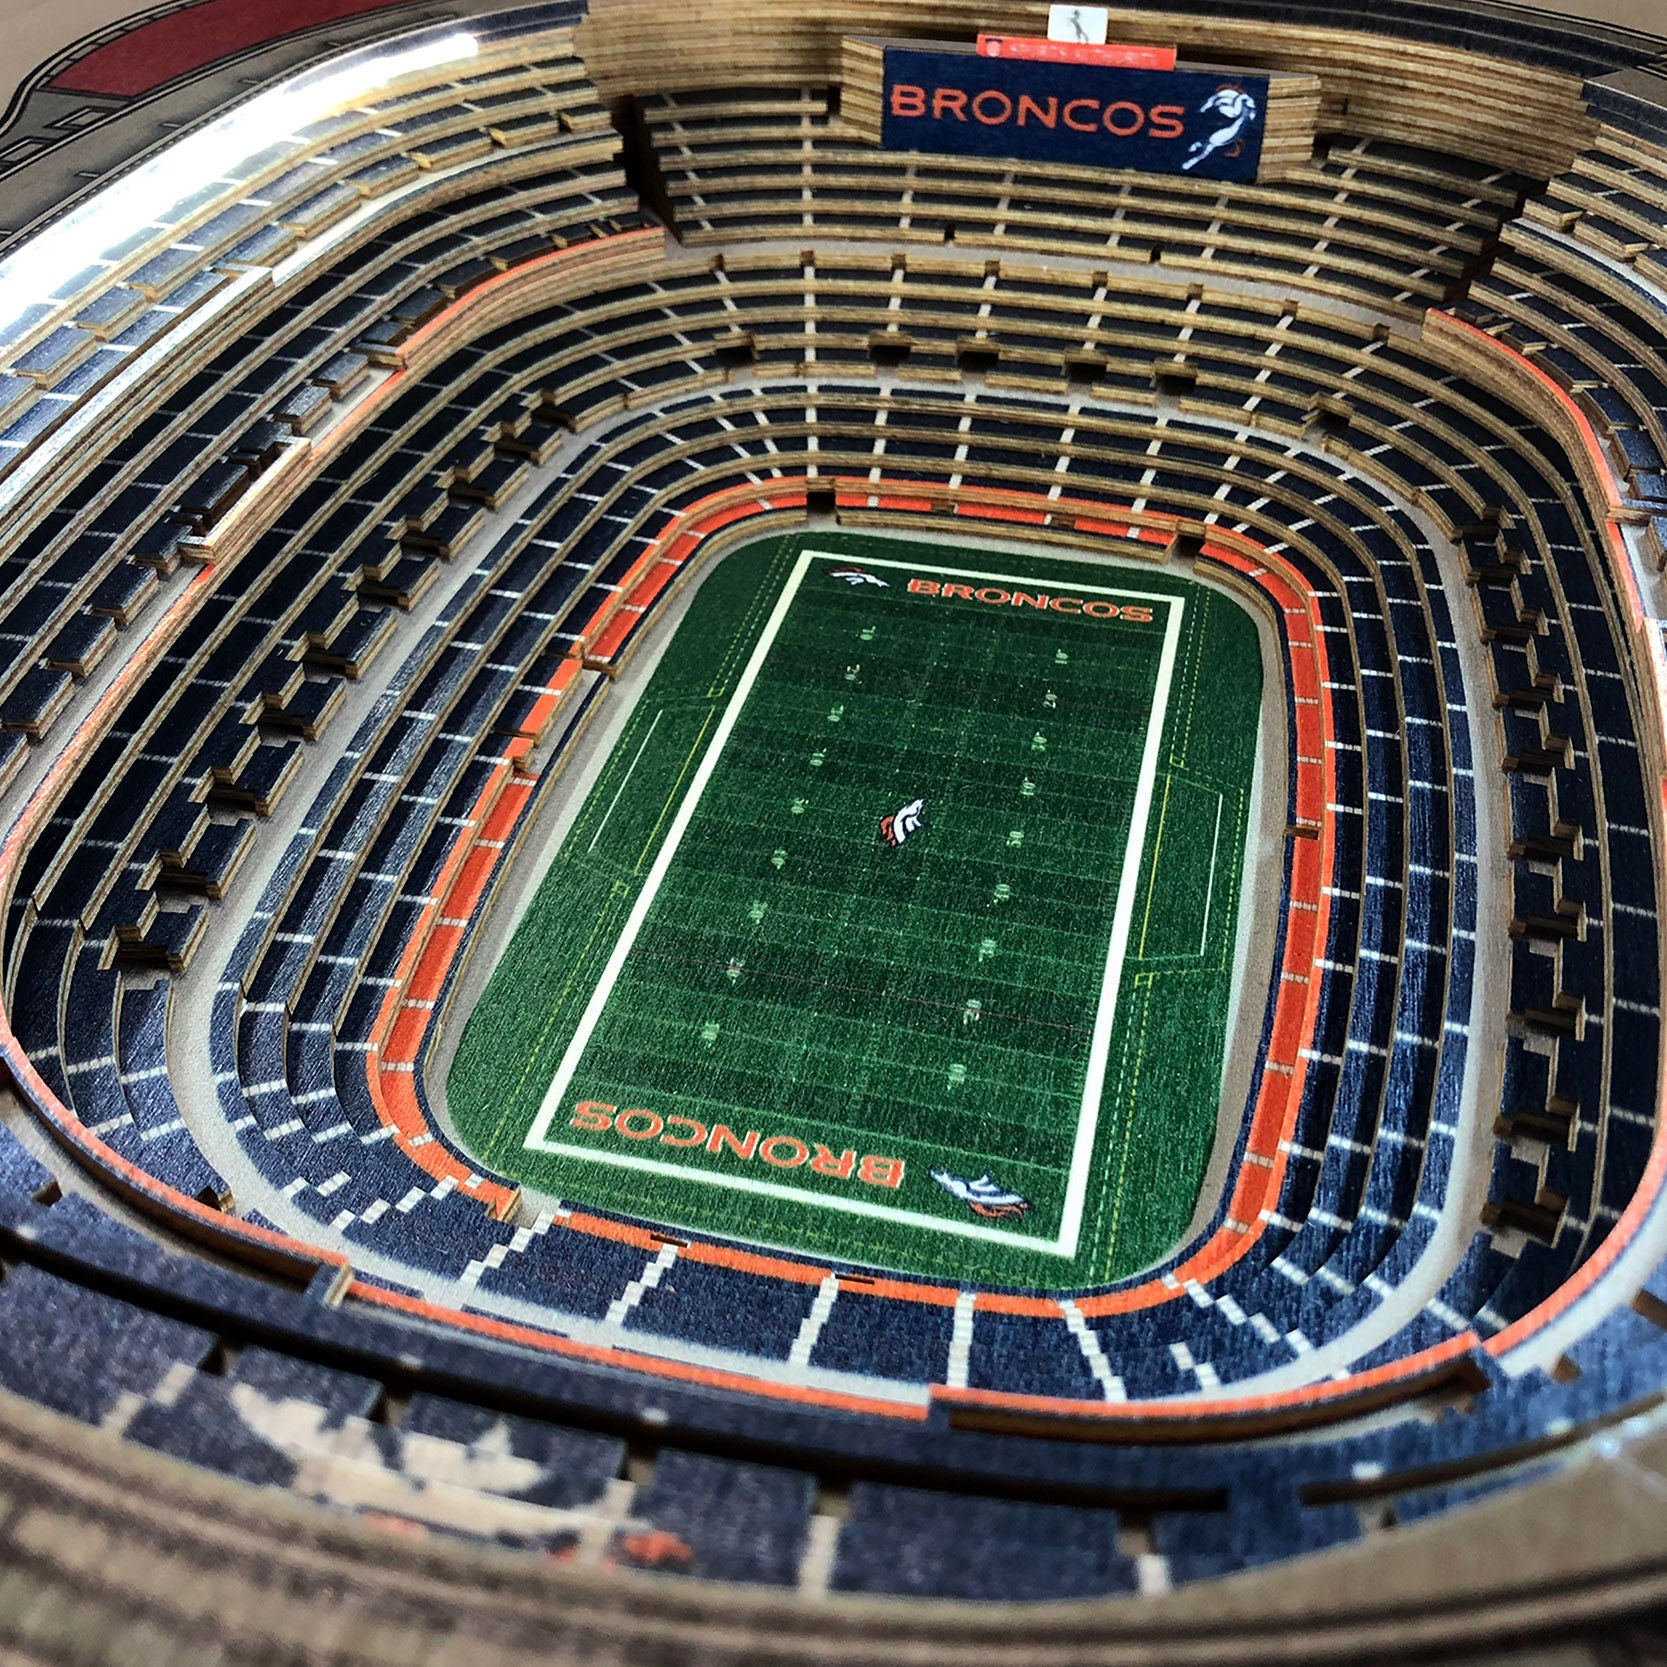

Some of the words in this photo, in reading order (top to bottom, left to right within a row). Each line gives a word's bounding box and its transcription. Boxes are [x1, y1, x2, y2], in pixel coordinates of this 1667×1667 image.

[890, 84, 1186, 139] BRONCOS
[907, 578, 1153, 623] BRONCOS
[570, 1099, 905, 1189] BRONCOS
